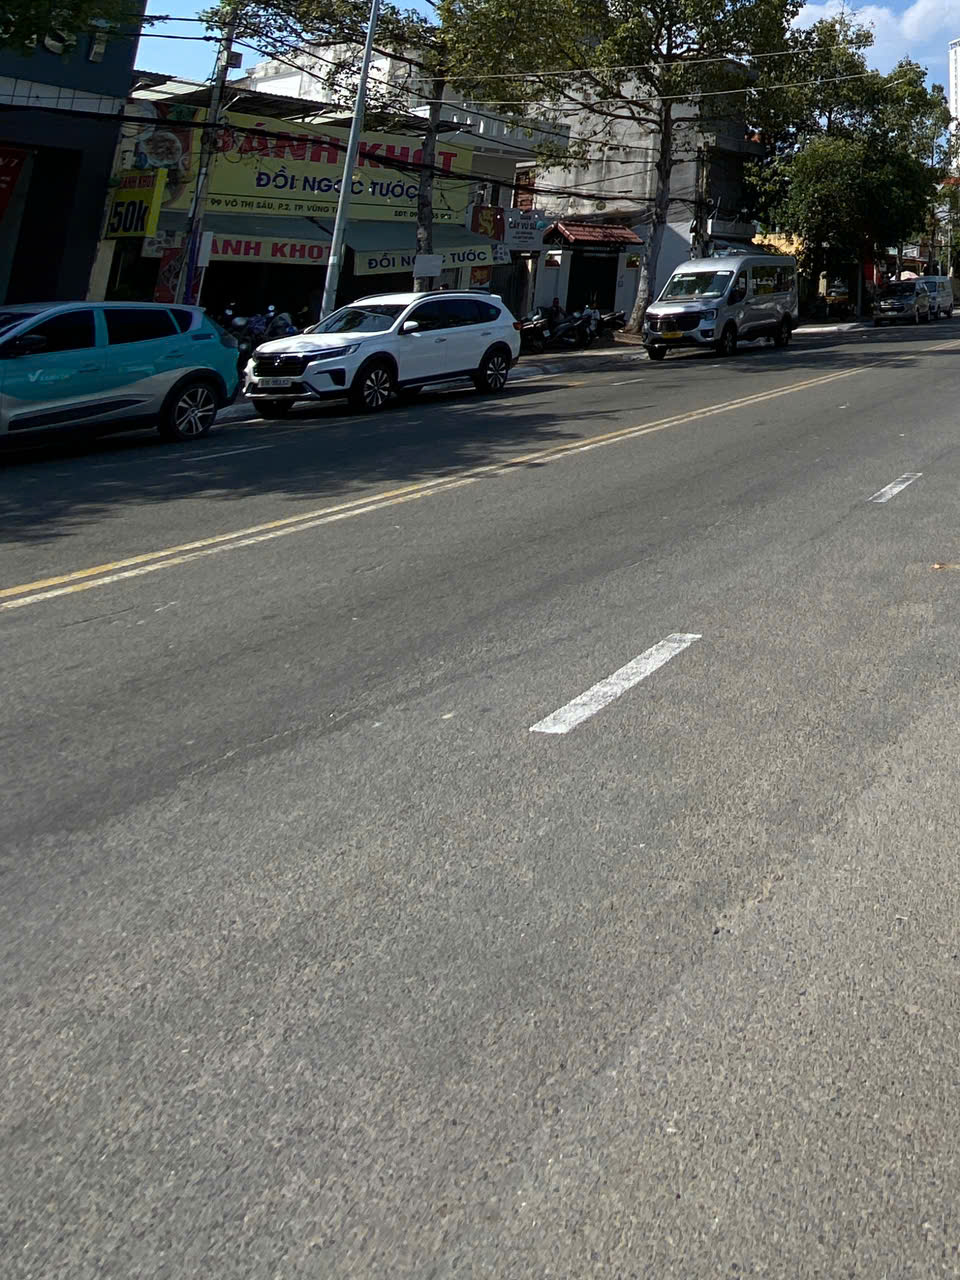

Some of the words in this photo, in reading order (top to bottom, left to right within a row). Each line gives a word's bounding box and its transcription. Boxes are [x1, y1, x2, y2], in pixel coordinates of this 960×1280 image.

[256, 165, 297, 190] ĐỒI
[369, 180, 418, 199] TƯỚC
[450, 249, 488, 263] TƯỚC
